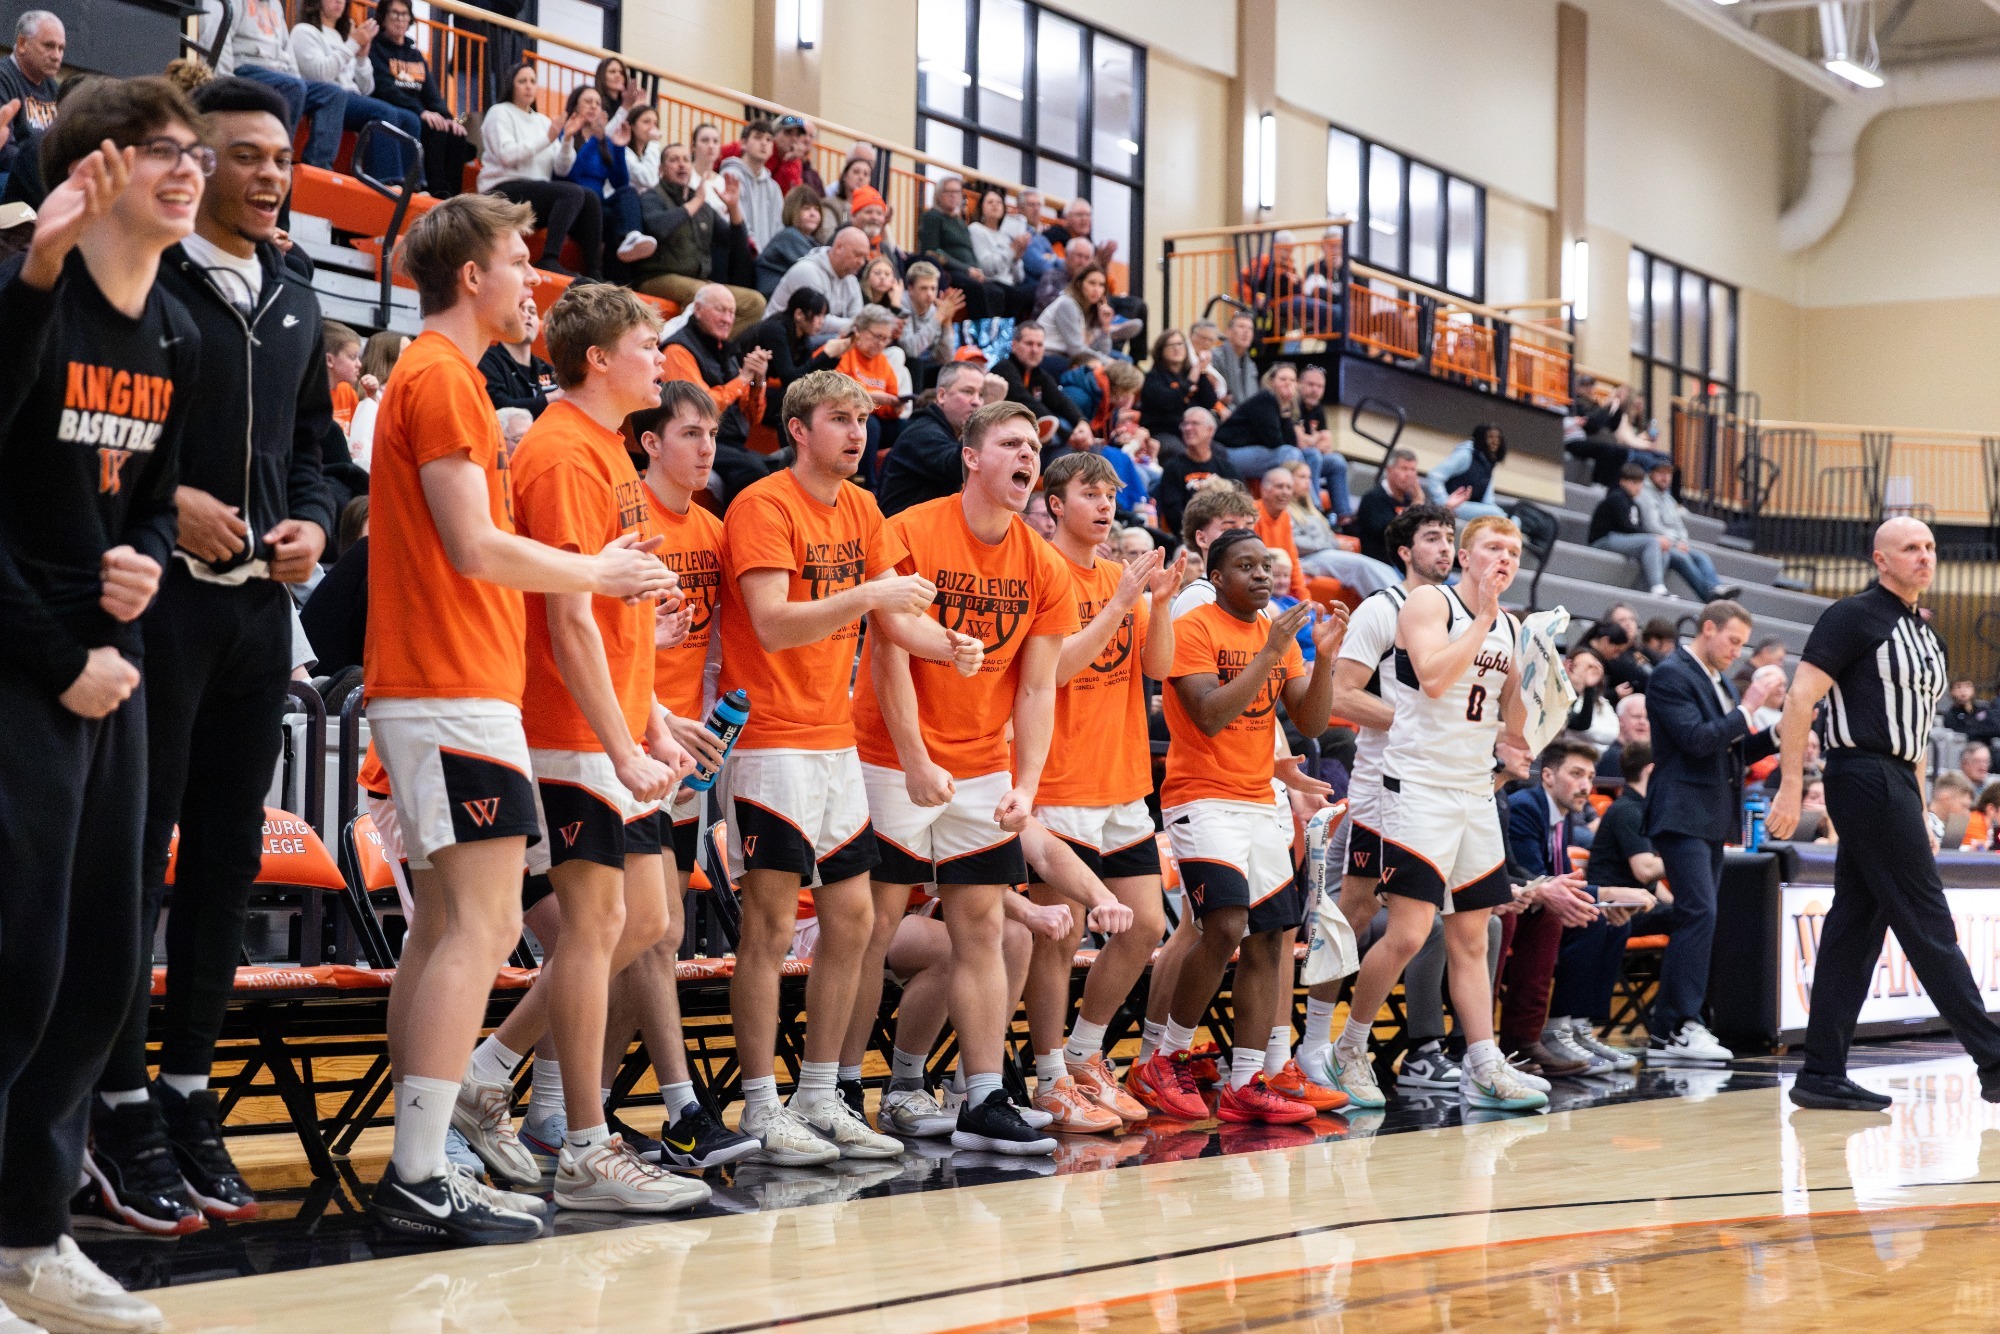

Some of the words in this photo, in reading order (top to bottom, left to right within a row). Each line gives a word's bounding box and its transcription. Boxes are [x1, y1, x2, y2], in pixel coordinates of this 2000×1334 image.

[680, 575, 694, 588] OFF
[698, 573, 717, 586] 2025
[936, 569, 976, 593] BUZZ
[980, 578, 1029, 598] LEVICK
[945, 594, 962, 606] TIP
[966, 597, 987, 610] OFF
[992, 601, 1019, 613] 2025
[923, 658, 951, 668] ORNELL
[1217, 649, 1248, 666] BUZZ
[1474, 650, 1509, 677] ight
[1466, 684, 1487, 722] 0
[462, 797, 500, 827] W
[262, 820, 309, 835] BURG
[560, 821, 584, 849] W
[262, 838, 306, 854] LEGE
[1354, 851, 1371, 868] W
[676, 963, 714, 978] NIGHTS
[245, 972, 318, 988] KNIGHTS
